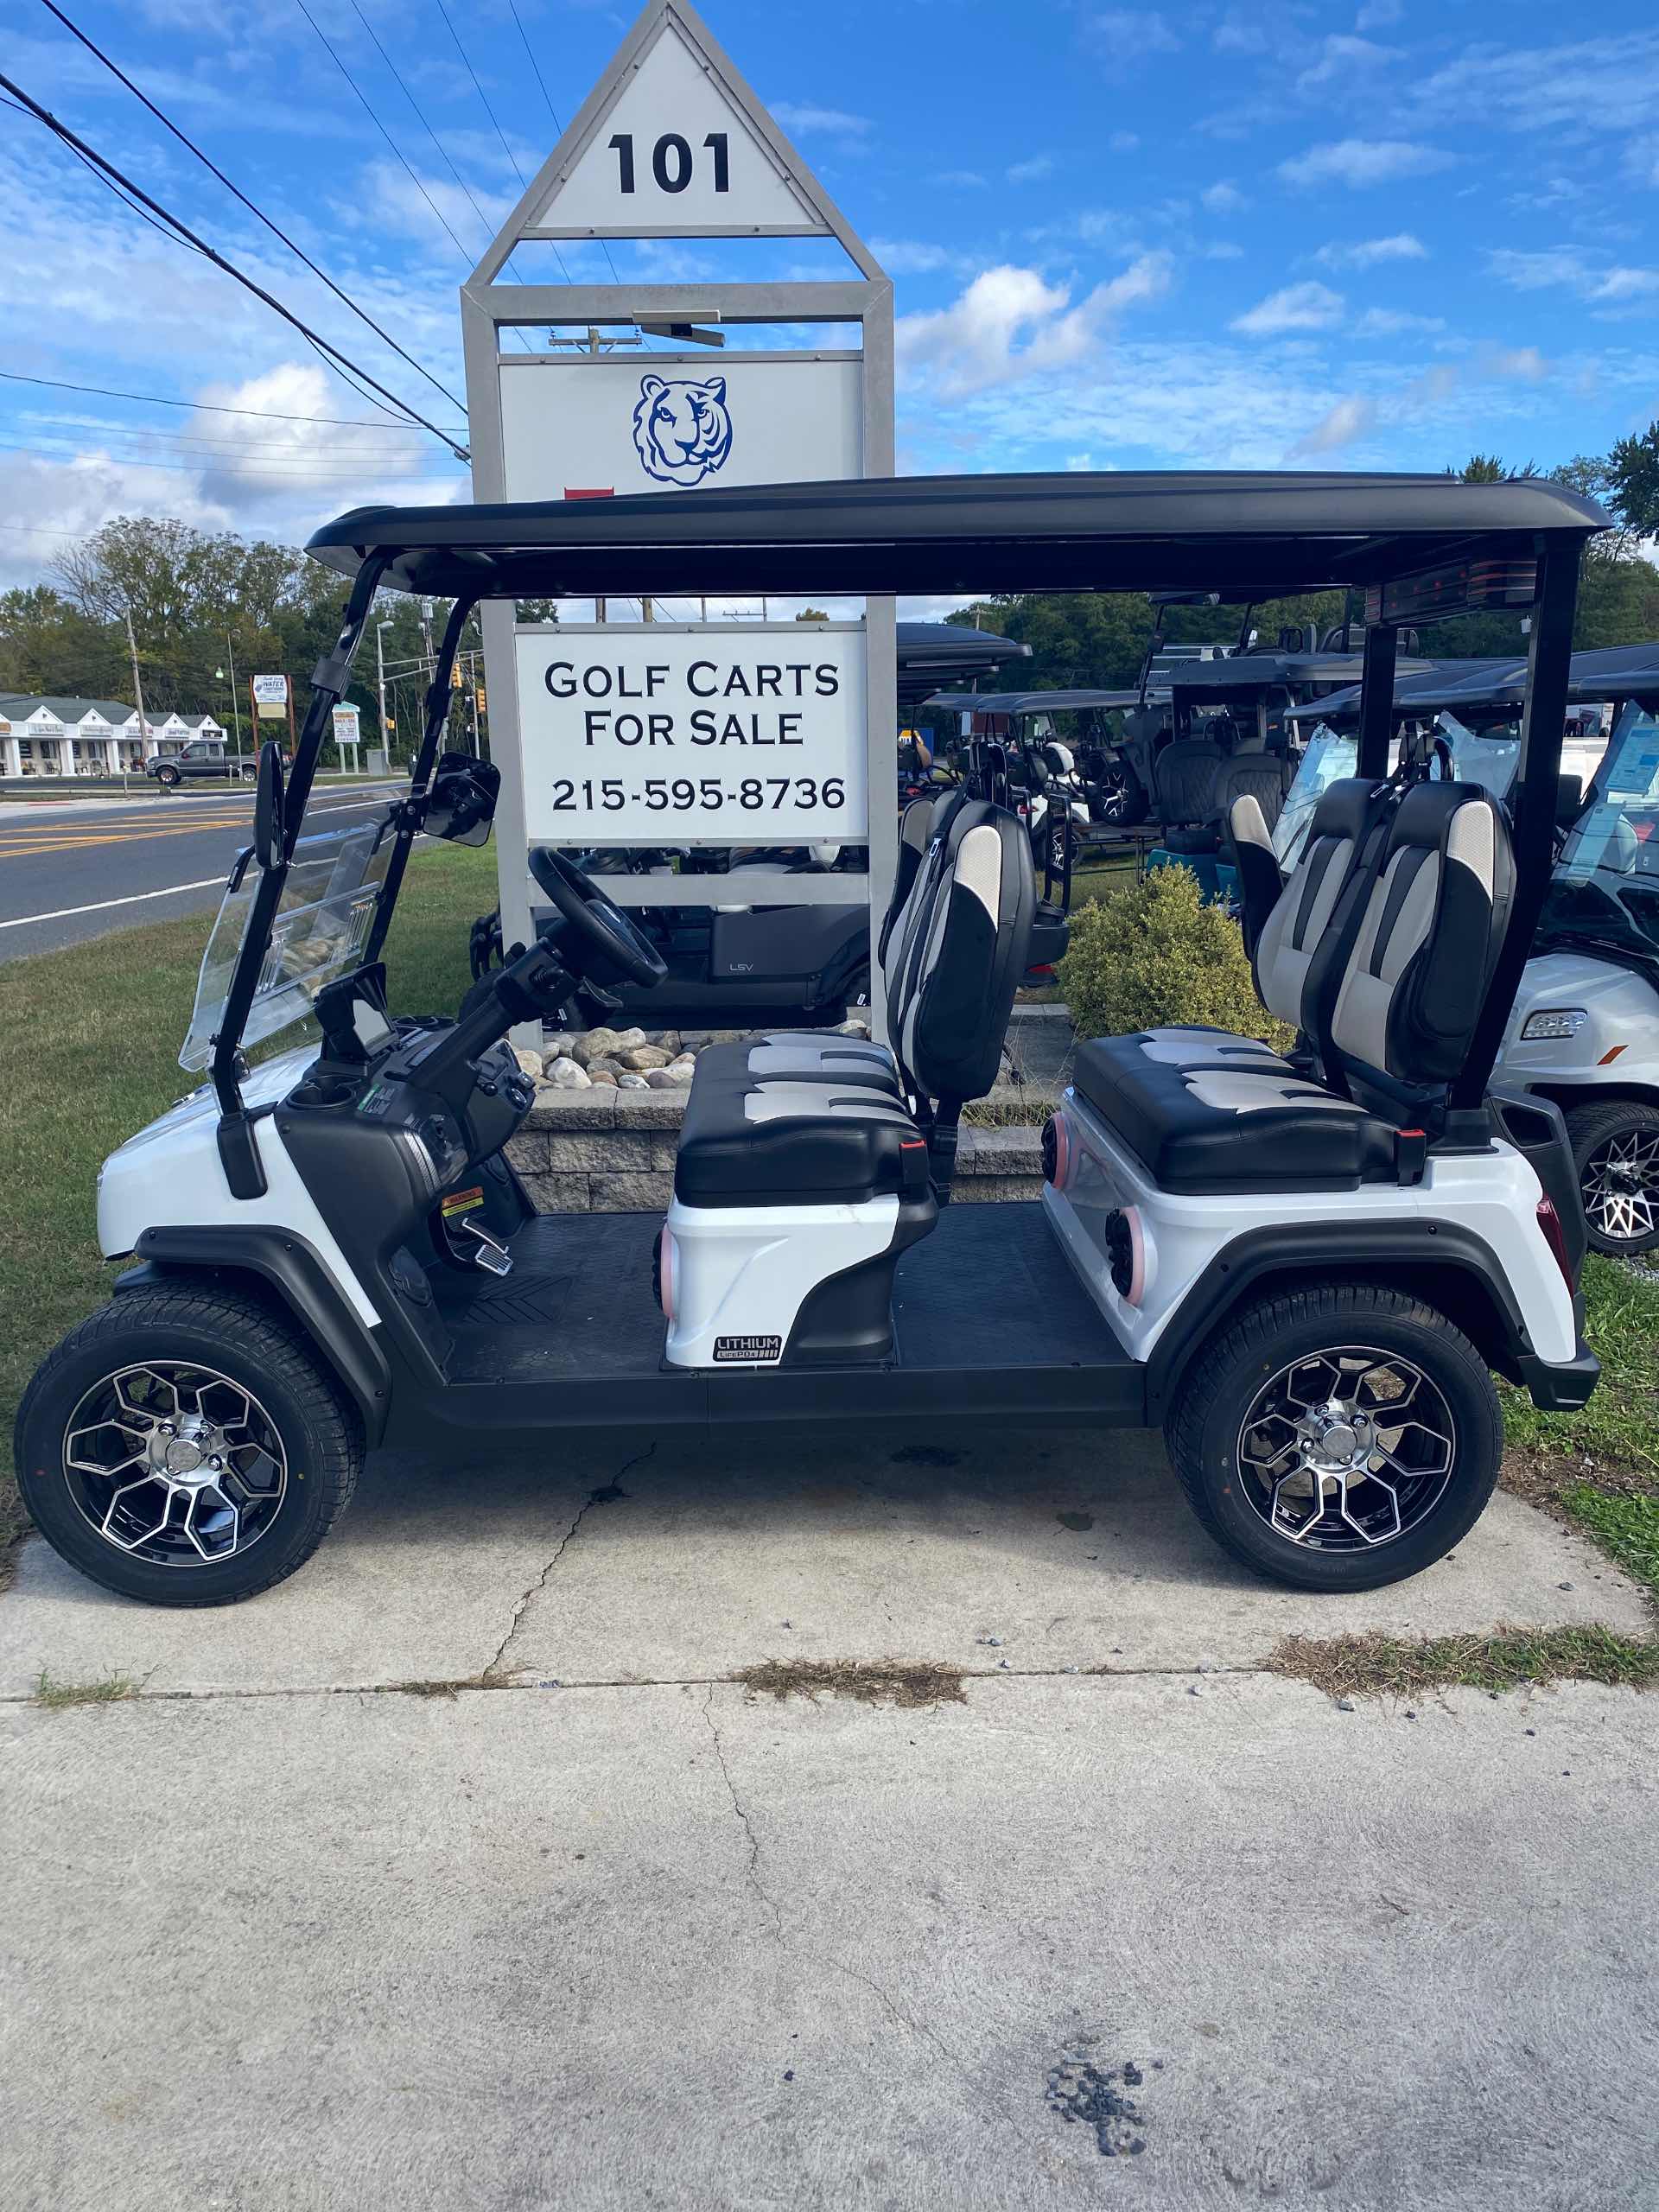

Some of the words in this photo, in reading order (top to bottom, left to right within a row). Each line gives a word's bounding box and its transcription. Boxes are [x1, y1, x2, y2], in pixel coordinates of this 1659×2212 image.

[607, 132, 729, 194] 101
[544, 661, 671, 698] GOLF
[686, 660, 839, 697] CARTS
[583, 709, 676, 747] FOR
[690, 709, 804, 746] SALE
[552, 777, 845, 811] 215-595-8736
[729, 963, 753, 972] LSV
[717, 1338, 779, 1349] LITHIUM
